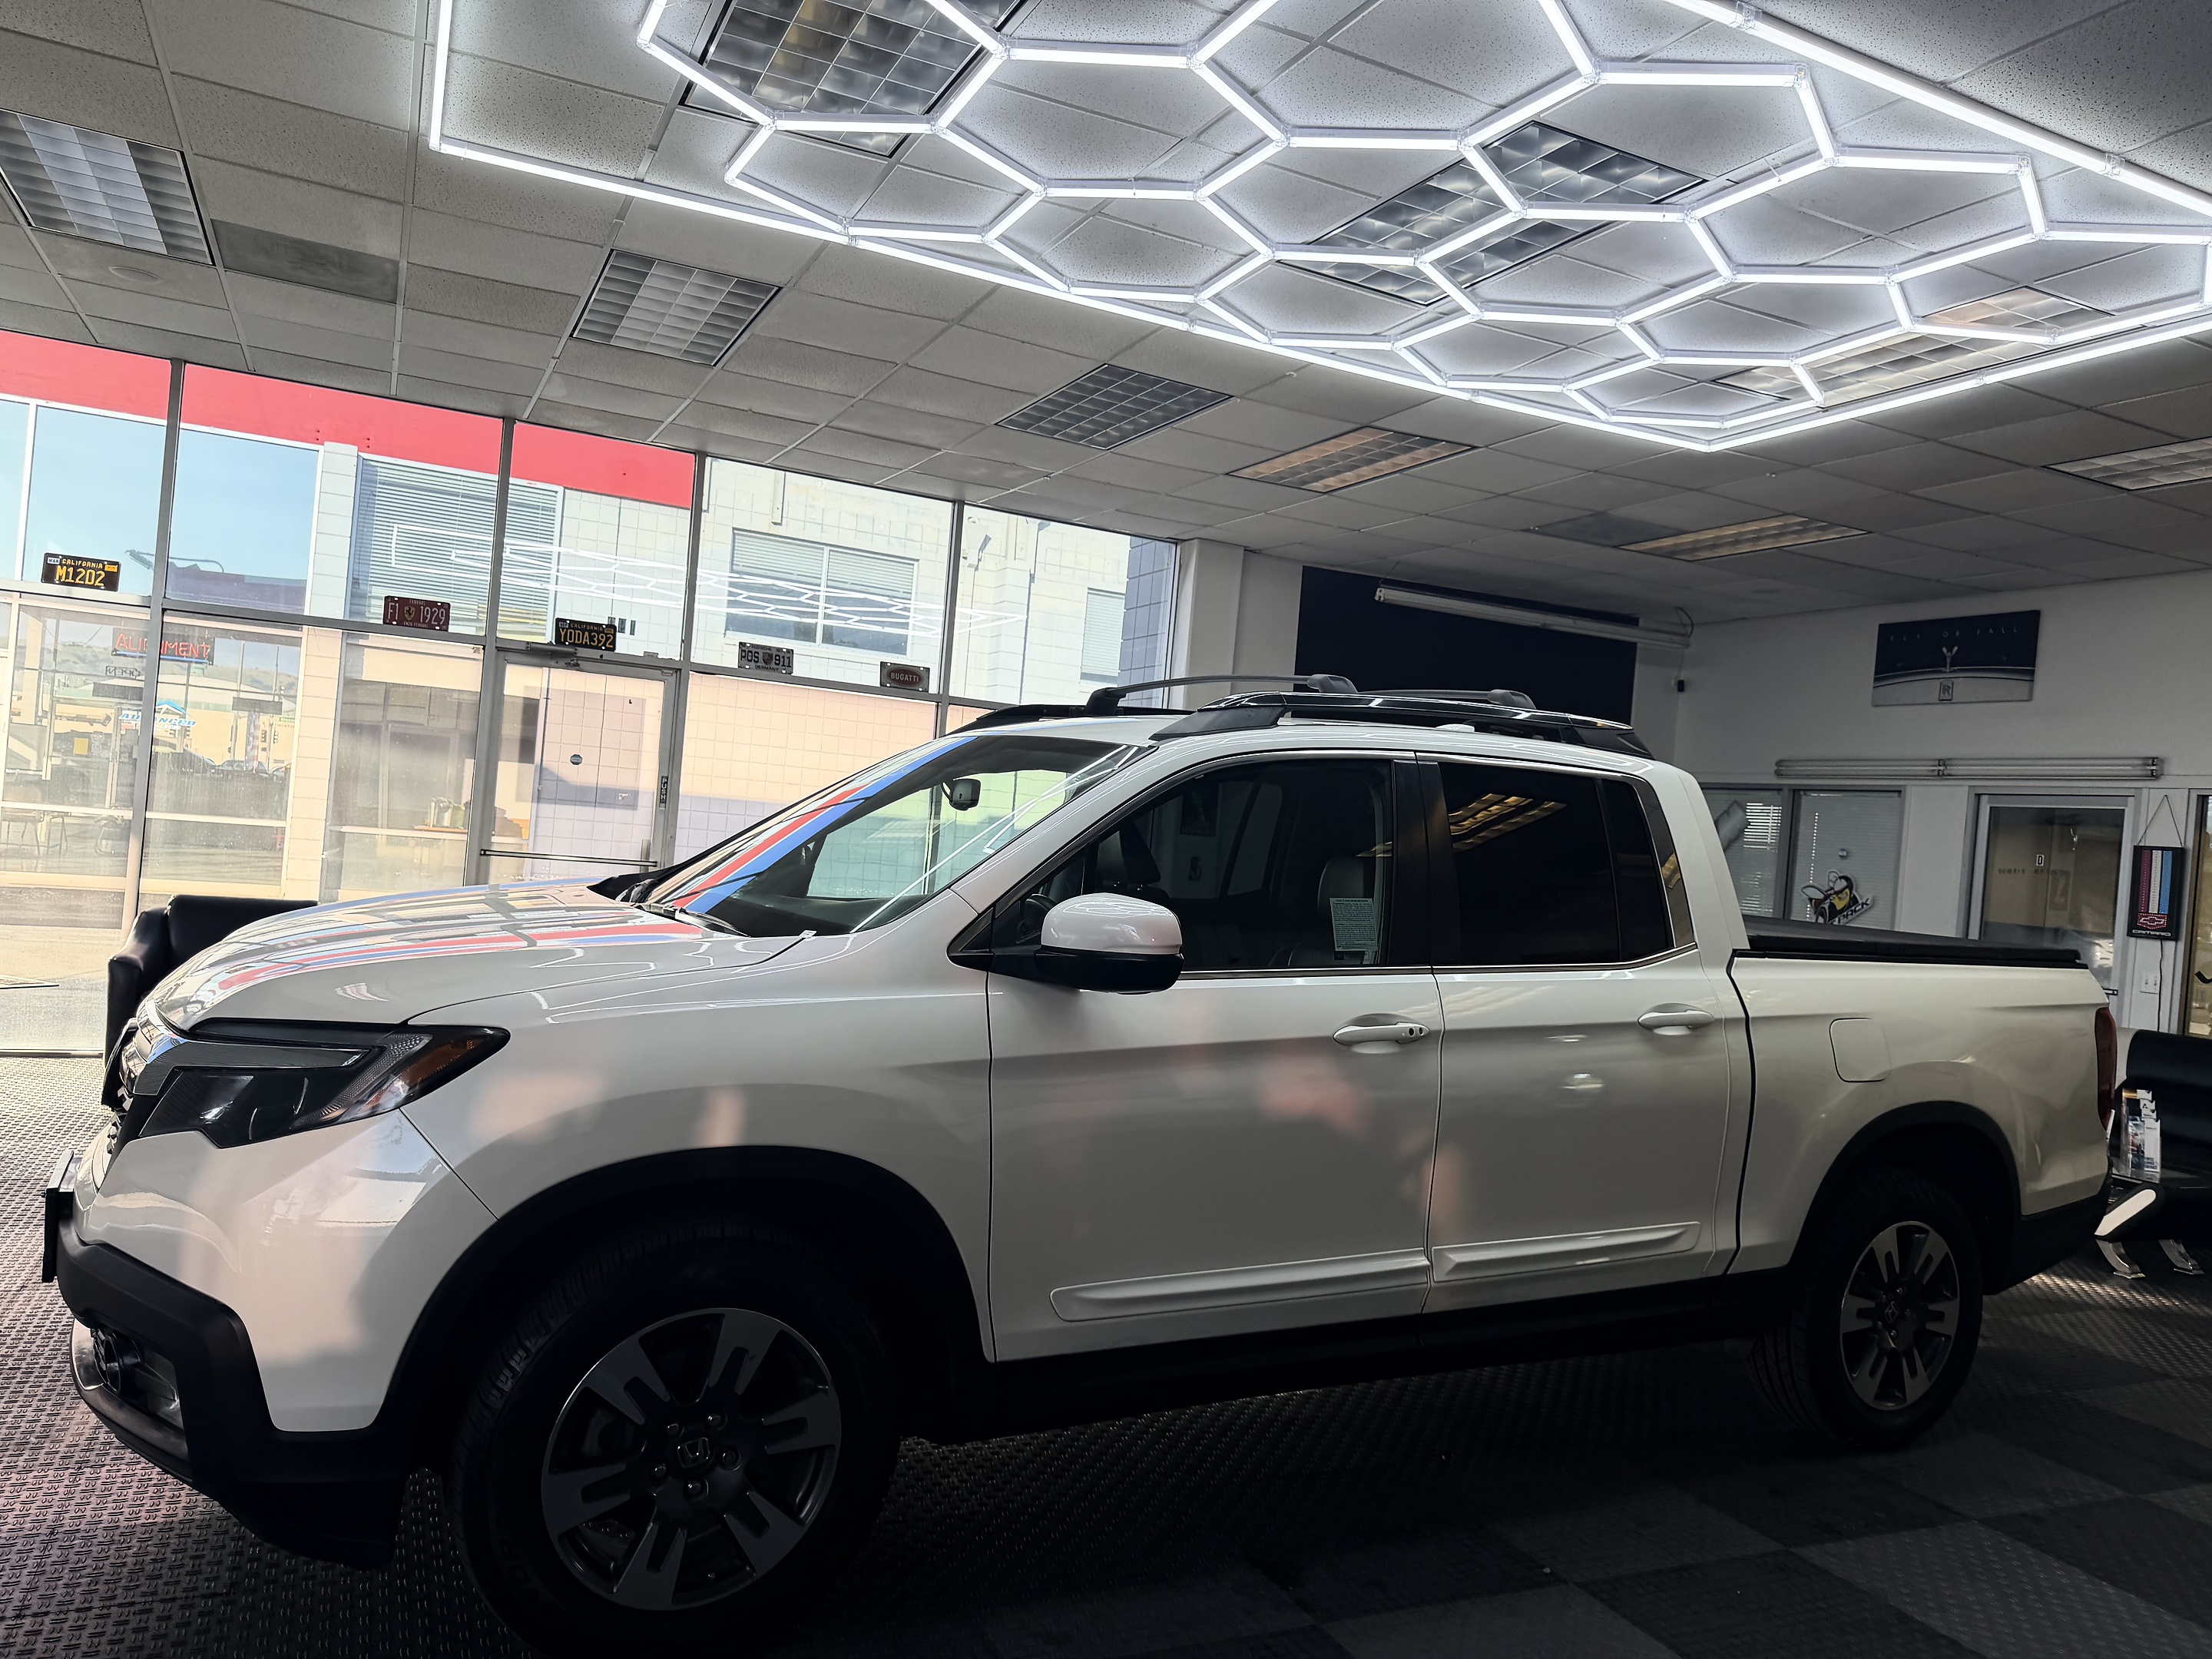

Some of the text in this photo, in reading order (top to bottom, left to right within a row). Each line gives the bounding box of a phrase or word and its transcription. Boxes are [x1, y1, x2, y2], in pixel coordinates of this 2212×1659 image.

[62, 558, 103, 569] CALIFORNIA
[388, 602, 445, 625] F1 1929
[571, 623, 603, 631] CALIFORNIA
[1976, 626, 2017, 635] FALL
[559, 628, 614, 648] YODA392
[115, 633, 210, 658] ALIMENT
[774, 654, 792, 668] 911
[890, 672, 919, 683] BUGATTI
